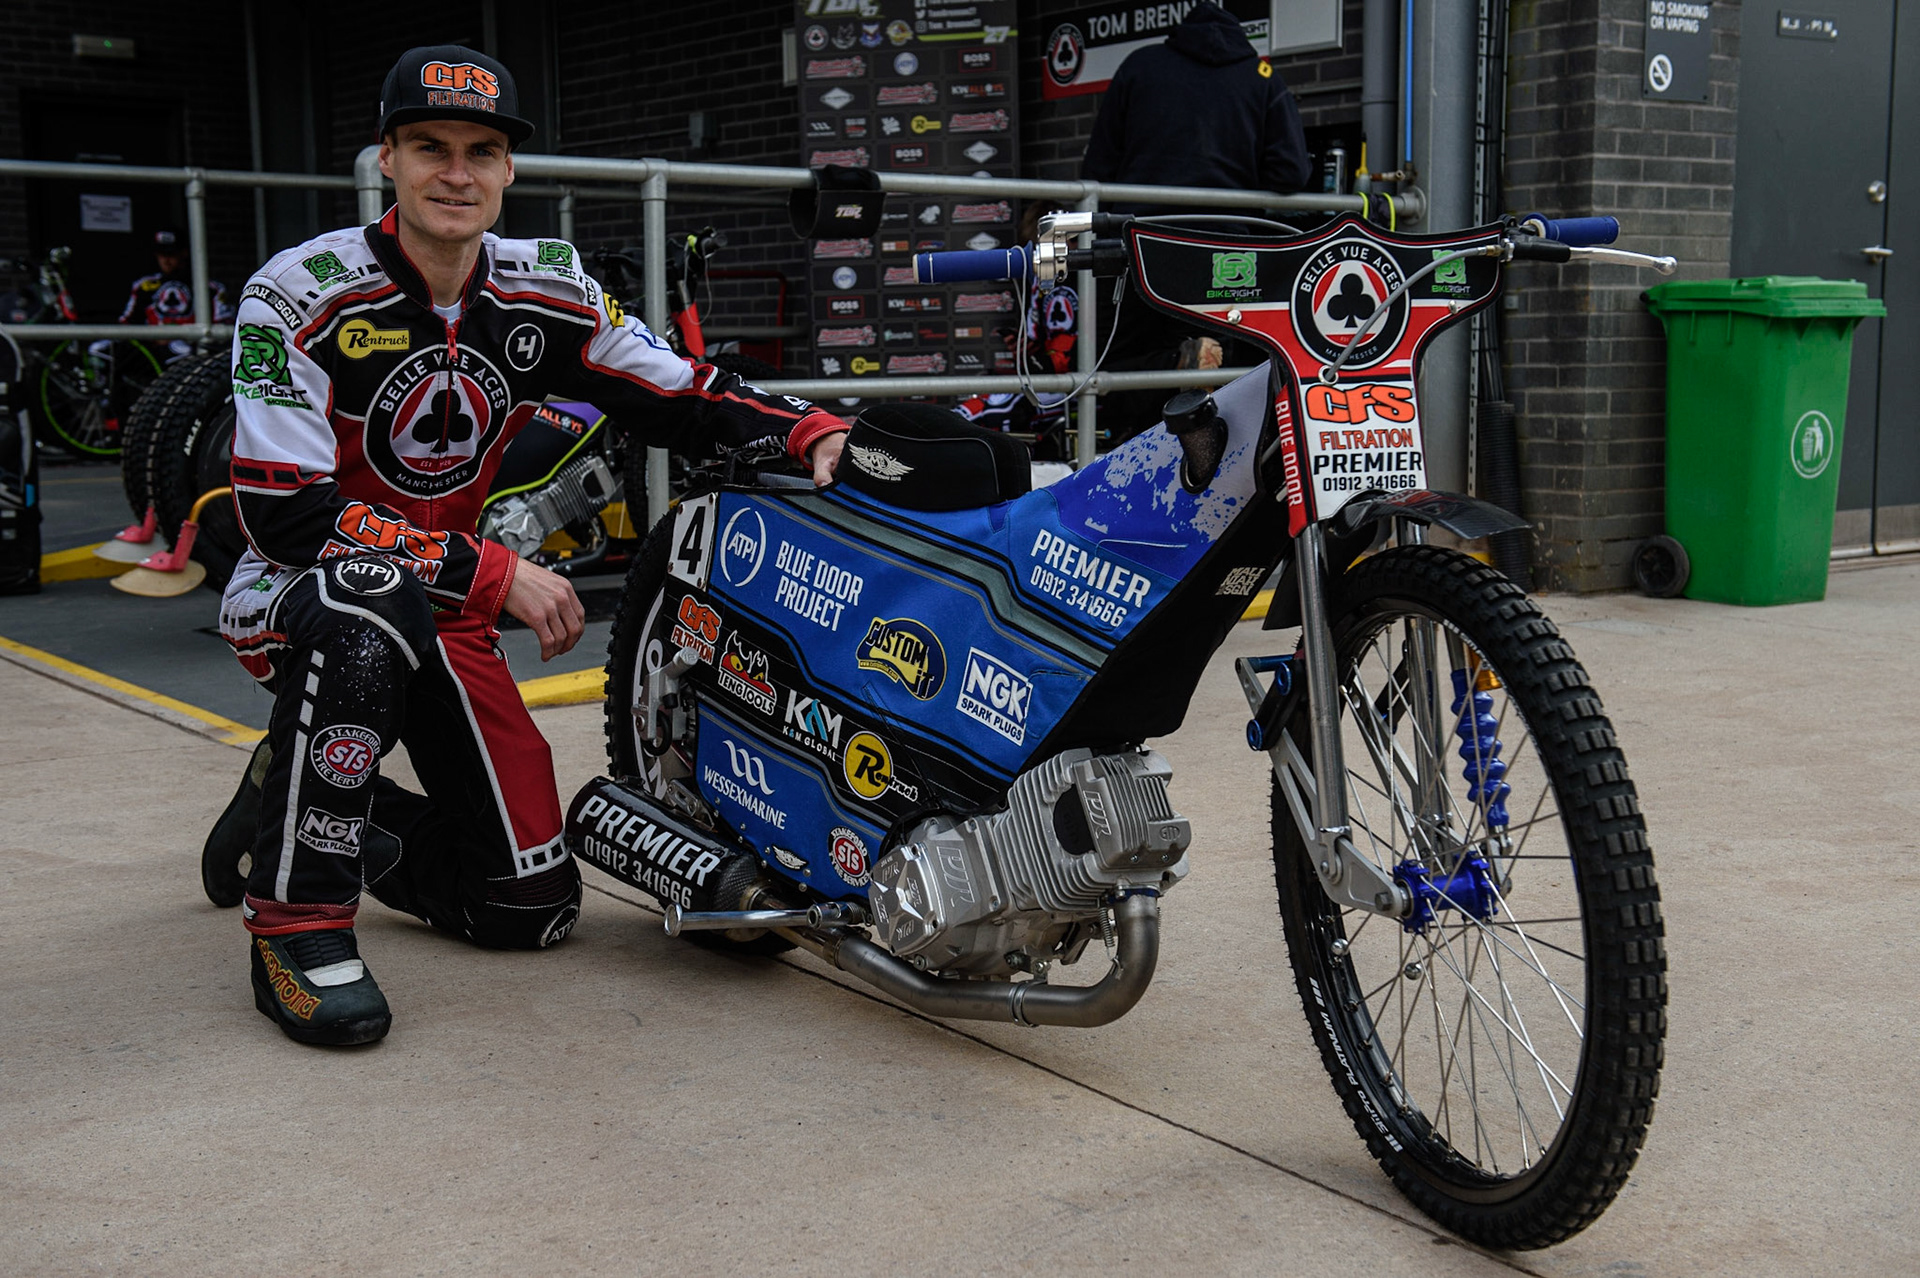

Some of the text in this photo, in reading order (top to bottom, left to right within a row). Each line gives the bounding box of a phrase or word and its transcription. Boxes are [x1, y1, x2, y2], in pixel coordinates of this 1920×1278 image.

[1088, 12, 1127, 39] TOM
[1651, 1, 1709, 19] NO SMOKING
[1651, 15, 1699, 33] OR VAPING
[421, 61, 500, 98] CFS
[428, 91, 496, 113] FILTRATION
[1300, 246, 1400, 293] BELLE VUE ACES
[1206, 288, 1262, 298] BIKERIGHT
[346, 328, 408, 349] Rentruck
[517, 335, 537, 360] 4
[379, 360, 428, 412] BELLE
[474, 367, 506, 409] ACES
[1305, 384, 1416, 425] CFS
[1274, 399, 1303, 507] BLUE DOOR
[1319, 429, 1414, 451] FILTRATION
[1313, 452, 1423, 475] PREMIER
[1323, 474, 1417, 491] 01912 341666
[335, 502, 450, 562] CFS
[677, 506, 706, 575] 4
[727, 531, 758, 564] ATPI
[342, 562, 393, 582] ATPI
[775, 540, 864, 607] BLUE DOOR
[1031, 529, 1151, 608] PREMIER
[774, 574, 846, 632] PROJECT
[1031, 564, 1128, 628] 01912 341666
[678, 594, 722, 644] CFS
[866, 620, 930, 670] CUSTOM
[966, 657, 1028, 724] NGK
[961, 697, 1023, 741] SPARK PLUGS
[328, 728, 381, 755] STAKEFORD
[329, 742, 369, 770] STS
[804, 736, 837, 762] GLOBAL
[314, 748, 332, 777] TYRE
[704, 764, 787, 830] WESSEXMARINE
[299, 832, 358, 855] SPARK PLUGS
[303, 812, 361, 846] NGK
[576, 795, 721, 888] PREMIER
[584, 835, 693, 910] 01912 341666
[838, 841, 859, 871] STS
[257, 938, 322, 1021] daytona
[1320, 1011, 1359, 1087] PLATINUM
